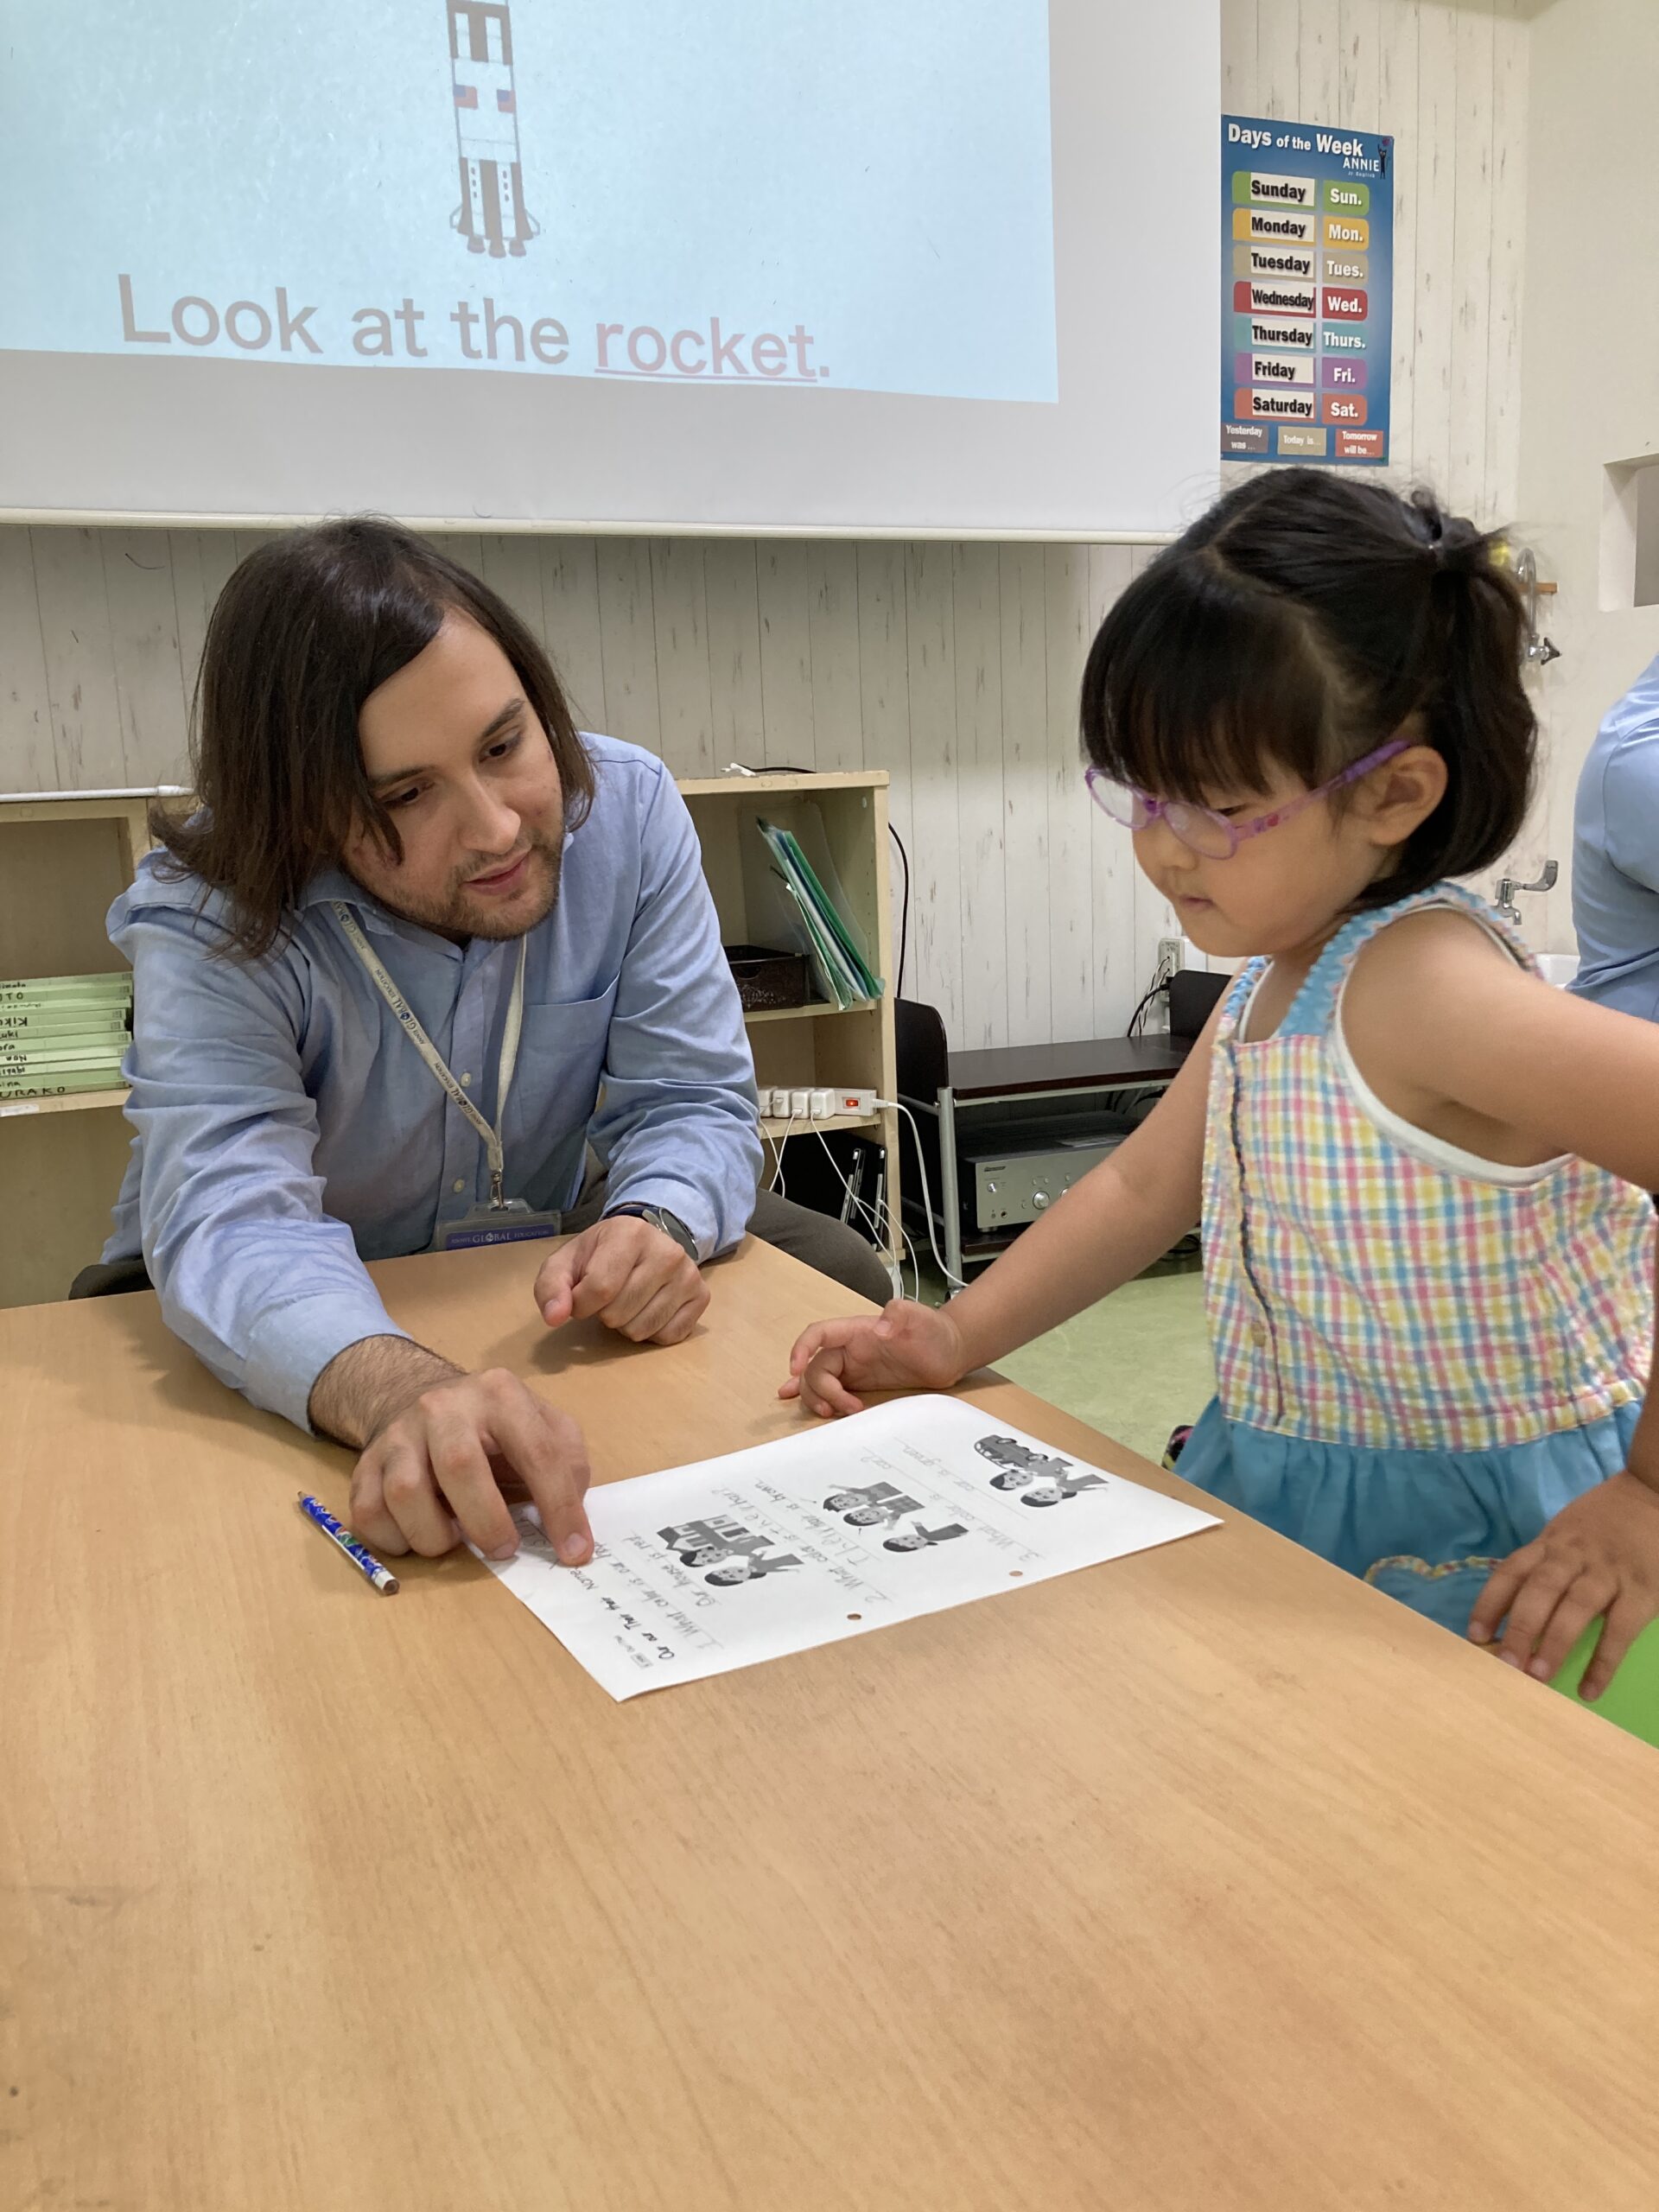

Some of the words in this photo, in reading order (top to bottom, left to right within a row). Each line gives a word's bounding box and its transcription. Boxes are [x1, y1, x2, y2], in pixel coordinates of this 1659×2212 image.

[1228, 124, 1272, 149] Days
[1276, 135, 1289, 148] of
[1292, 137, 1311, 150] the
[1317, 134, 1363, 156] Week
[1343, 156, 1380, 172] ANNIE
[1251, 180, 1306, 202] Sunday
[1330, 188, 1362, 205] Sun.
[1252, 217, 1306, 238] Monday
[1328, 224, 1363, 241] Mon.
[1251, 253, 1310, 274] Tuesday
[1326, 260, 1363, 277] Tues.
[1252, 289, 1314, 311] Wednesday
[1327, 296, 1362, 313] Wed.
[118, 273, 324, 354] Look
[351, 298, 429, 358] at
[449, 297, 570, 364] the
[594, 318, 830, 378] rocket.
[1252, 325, 1313, 346] Thursday
[1324, 332, 1366, 348] Thurs.
[1255, 361, 1295, 380] Friday
[1333, 367, 1356, 383] Fri.
[1253, 397, 1313, 416] Saturday
[1331, 402, 1358, 417] Sat.
[1225, 424, 1262, 438] Yesterday
[1342, 430, 1377, 441] Tomorrow
[1283, 435, 1305, 446] Today
[1344, 446, 1357, 454] will
[375, 968, 397, 999] EDUCATION
[392, 998, 417, 1030] GLOBAL
[451, 1088, 474, 1114] GLOBAL
[472, 1232, 512, 1244] GLOBAL
[657, 1646, 675, 1659] Our
